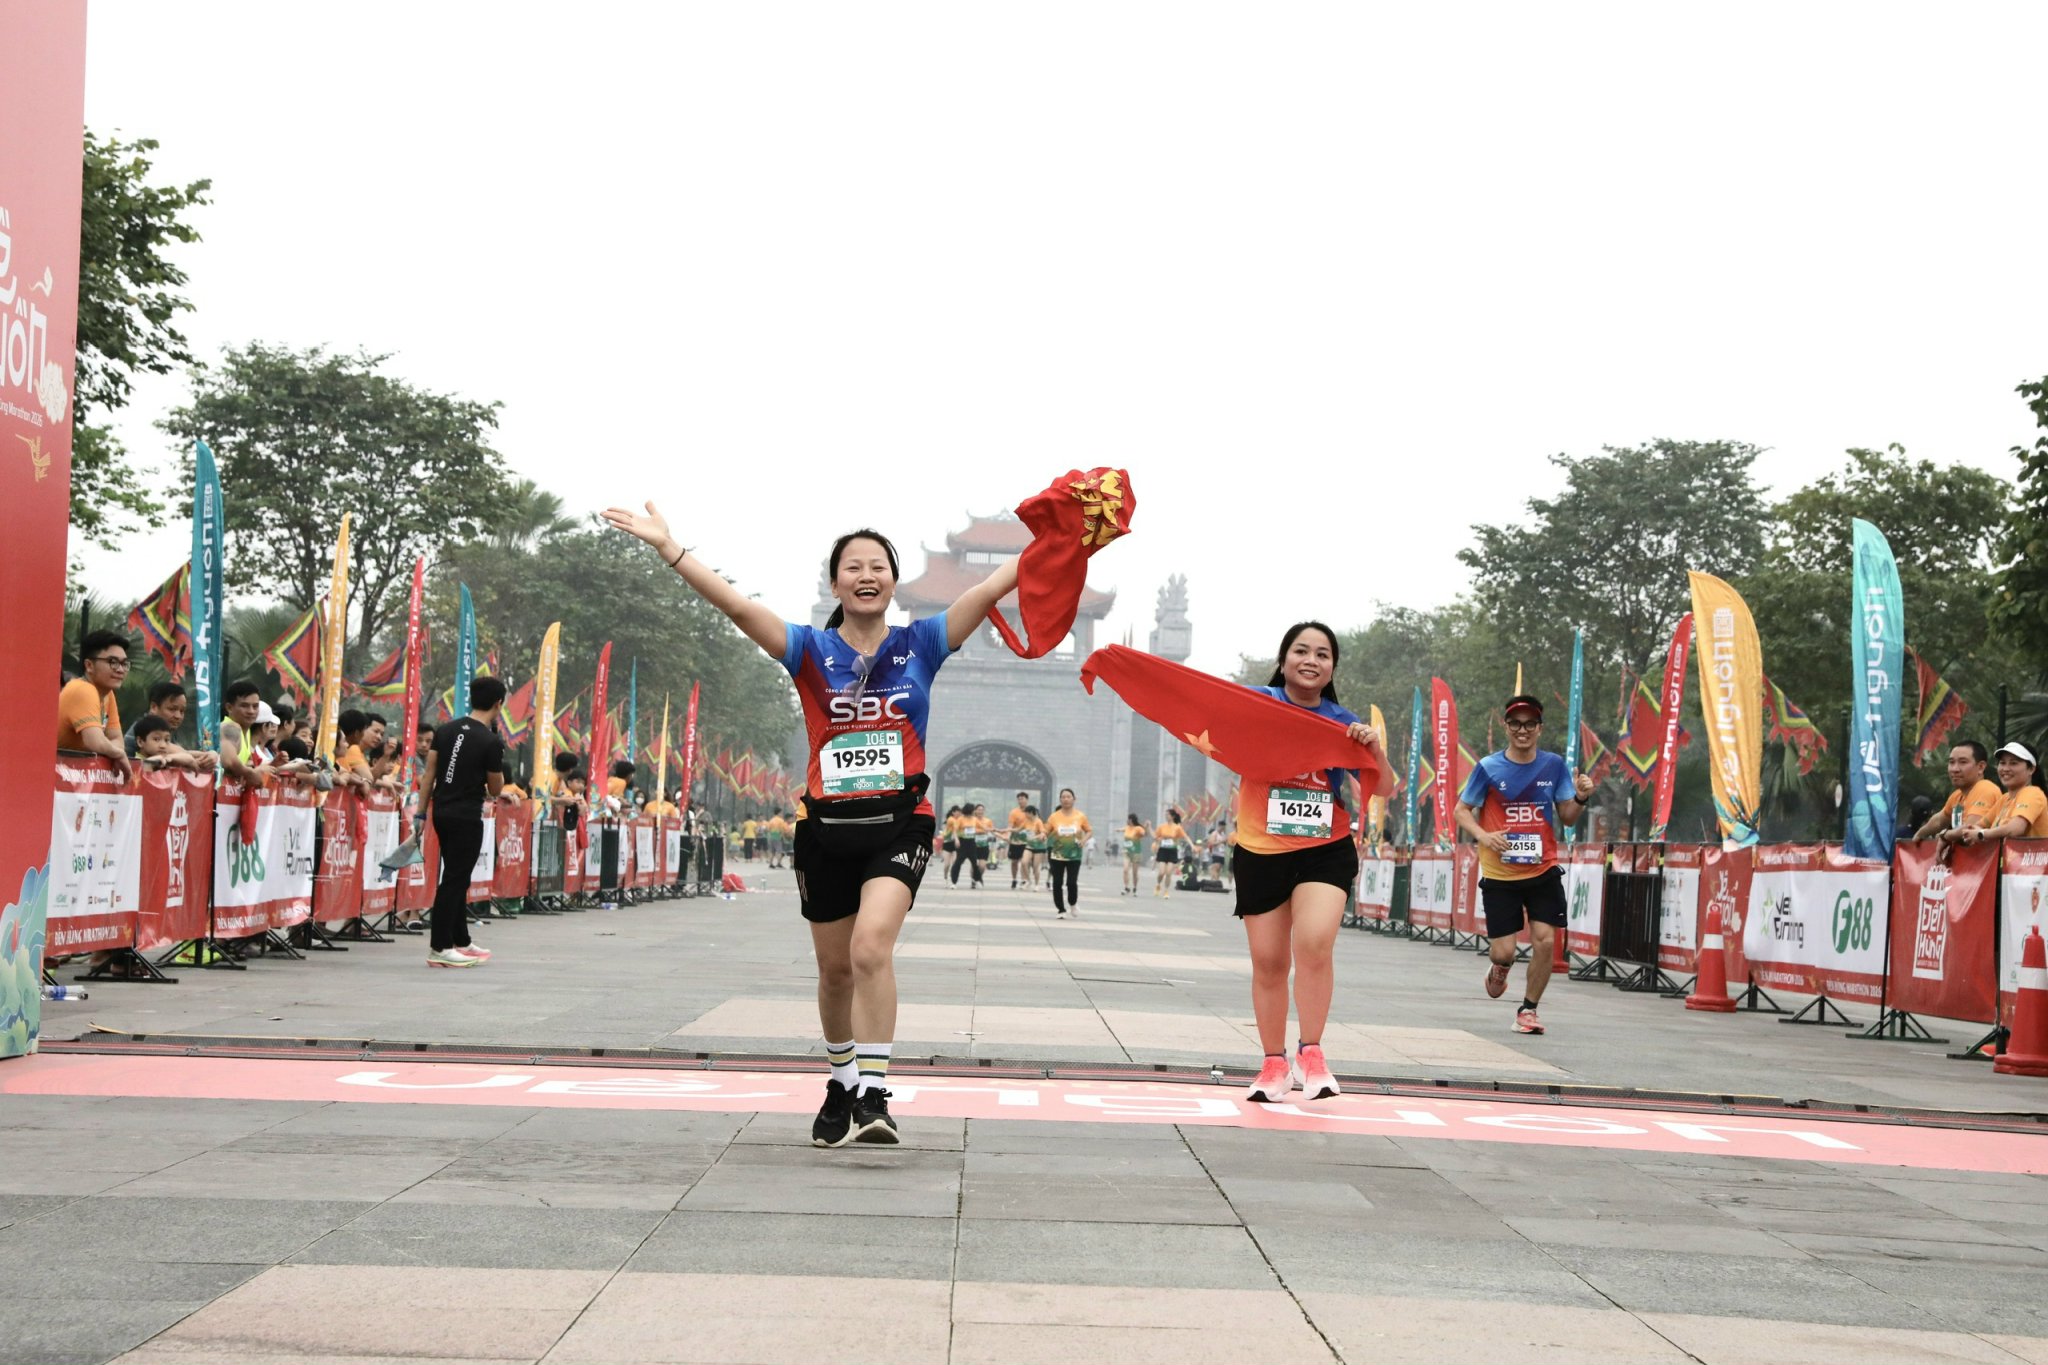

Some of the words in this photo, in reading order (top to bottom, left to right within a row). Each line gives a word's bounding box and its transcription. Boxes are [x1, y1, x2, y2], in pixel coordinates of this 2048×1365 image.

[829, 692, 910, 724] SBC
[445, 734, 465, 784] ORGANIZER
[833, 749, 890, 769] 19595
[1280, 802, 1322, 818] 16124
[1505, 806, 1545, 823] SBC
[1508, 842, 1536, 851] 26158
[1833, 890, 1873, 954] F88
